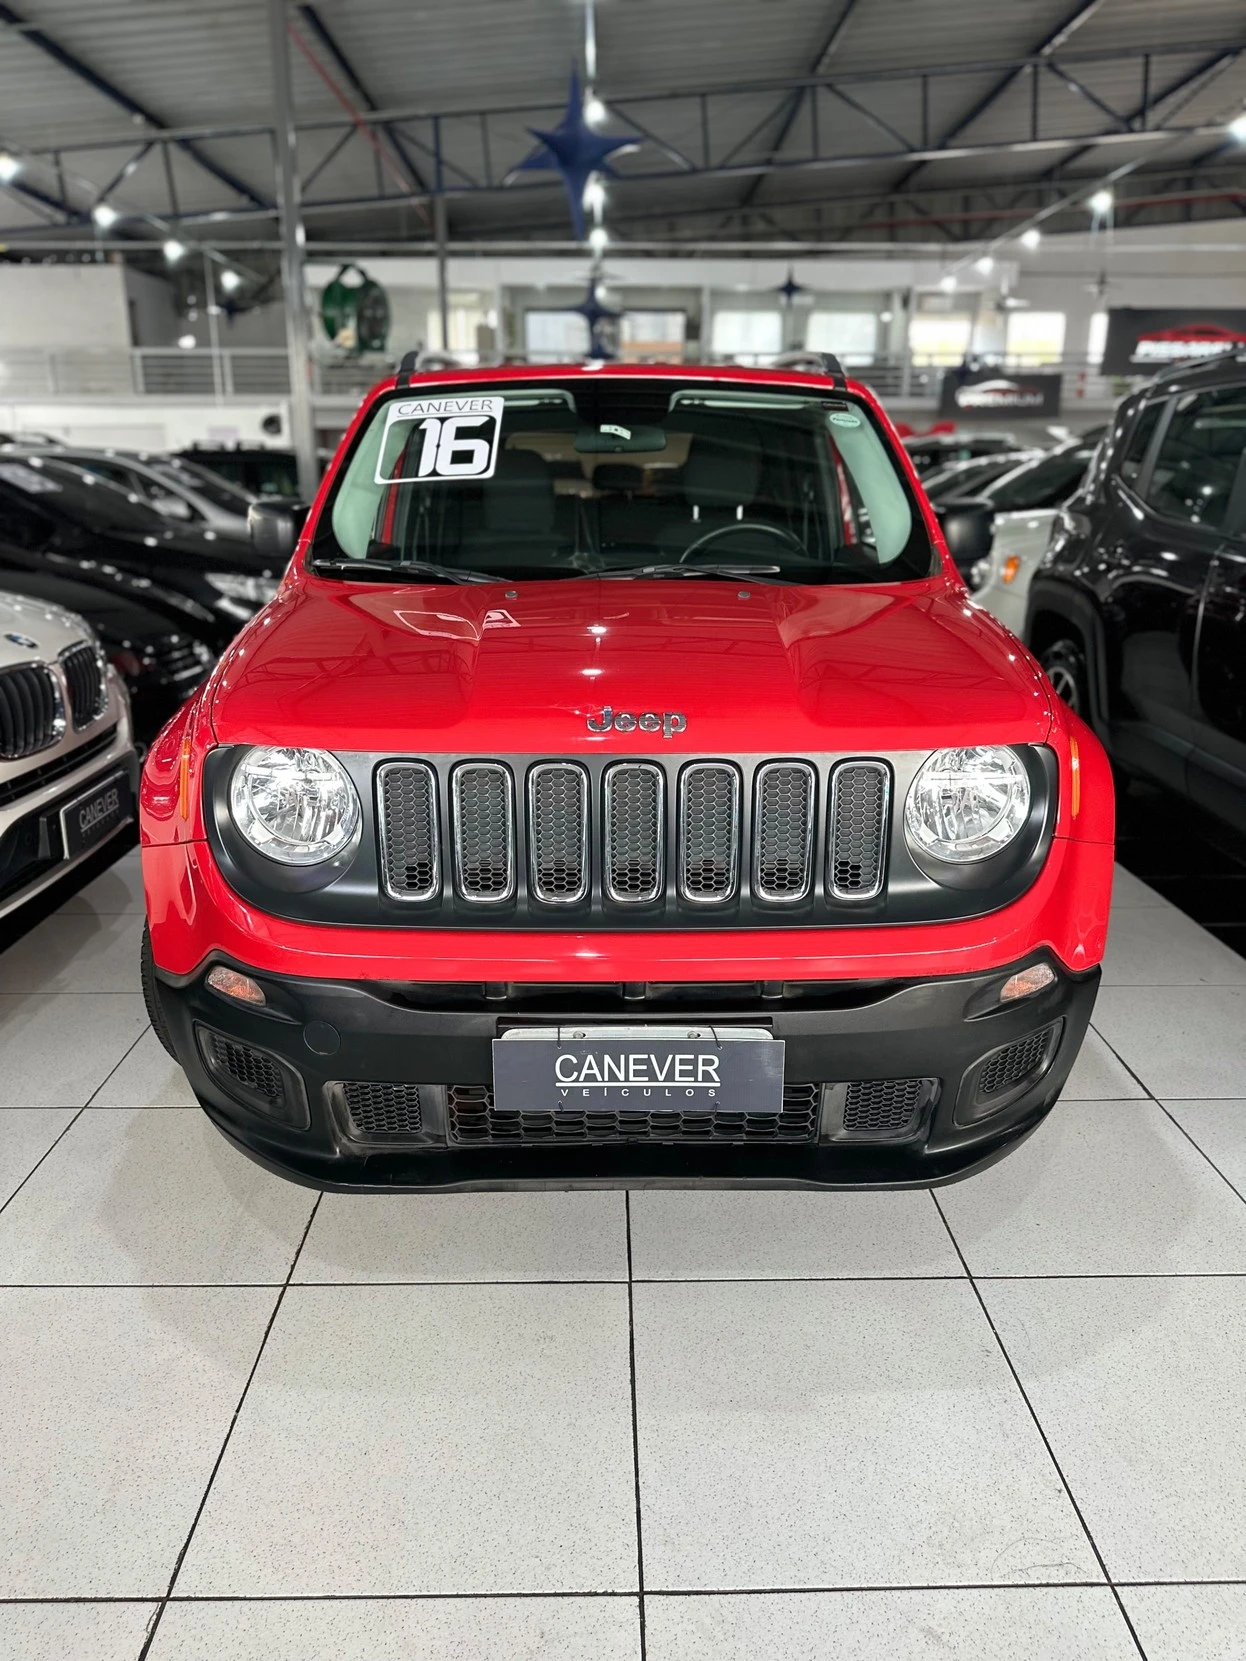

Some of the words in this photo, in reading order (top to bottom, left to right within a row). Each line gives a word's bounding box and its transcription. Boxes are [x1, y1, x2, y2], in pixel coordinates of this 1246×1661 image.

[397, 399, 494, 416] CANEVER
[418, 416, 491, 477] 16
[586, 705, 688, 739] Jeep
[79, 788, 120, 829] CANEVER
[554, 1053, 721, 1082] CANEVER
[560, 1087, 717, 1098] VEÍCULOS
